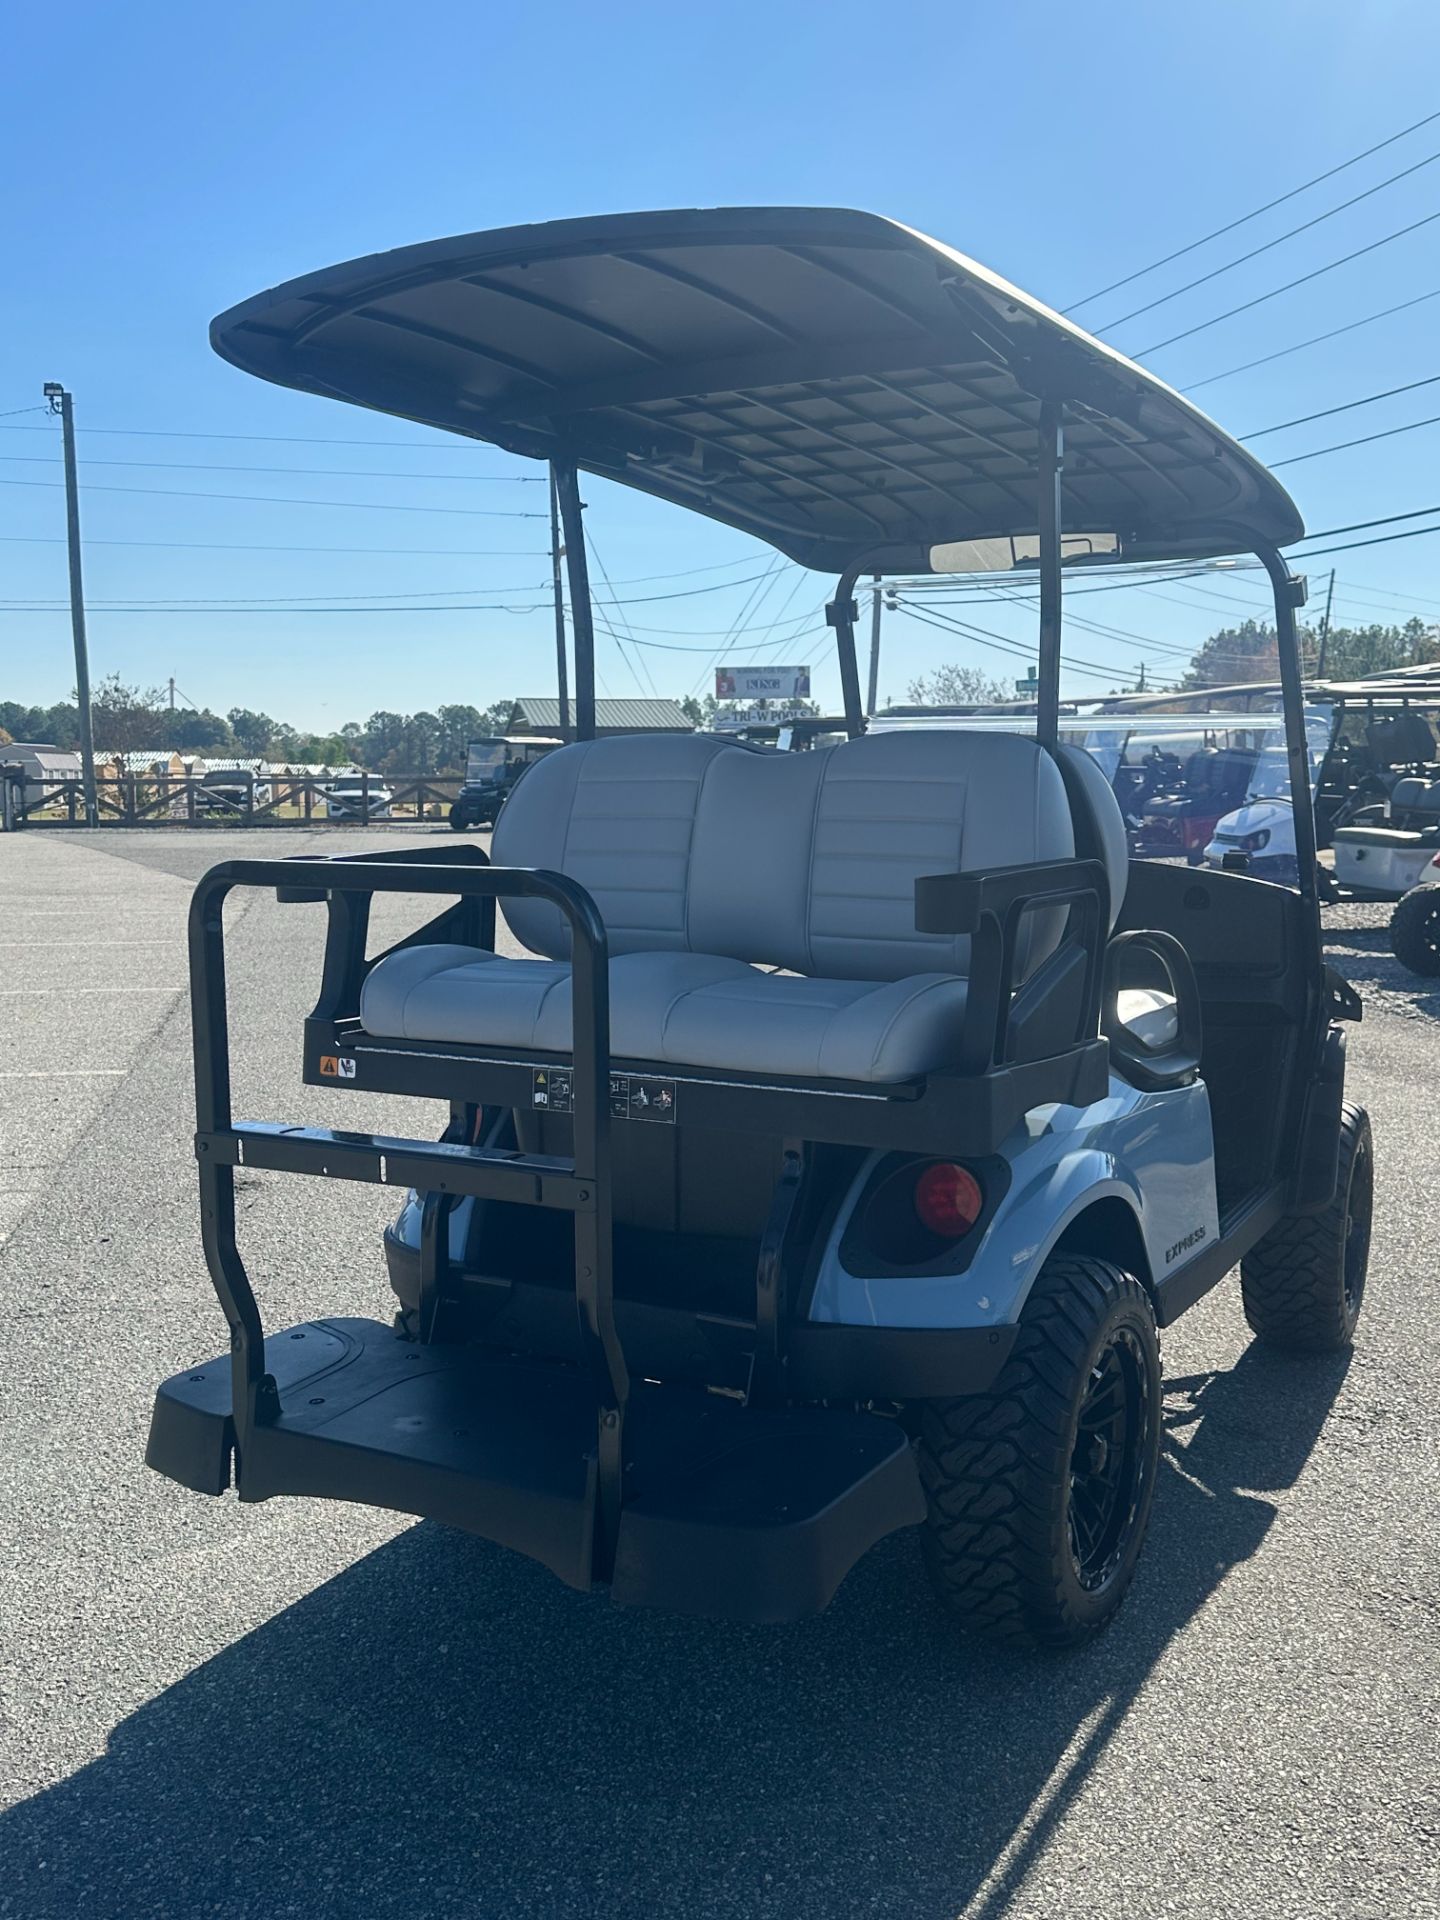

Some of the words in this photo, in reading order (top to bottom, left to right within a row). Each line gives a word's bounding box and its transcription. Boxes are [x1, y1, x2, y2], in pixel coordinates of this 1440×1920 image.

[746, 679, 780, 689] KING
[732, 711, 769, 722] TRI-W
[1165, 1224, 1206, 1265] EXPRESS
